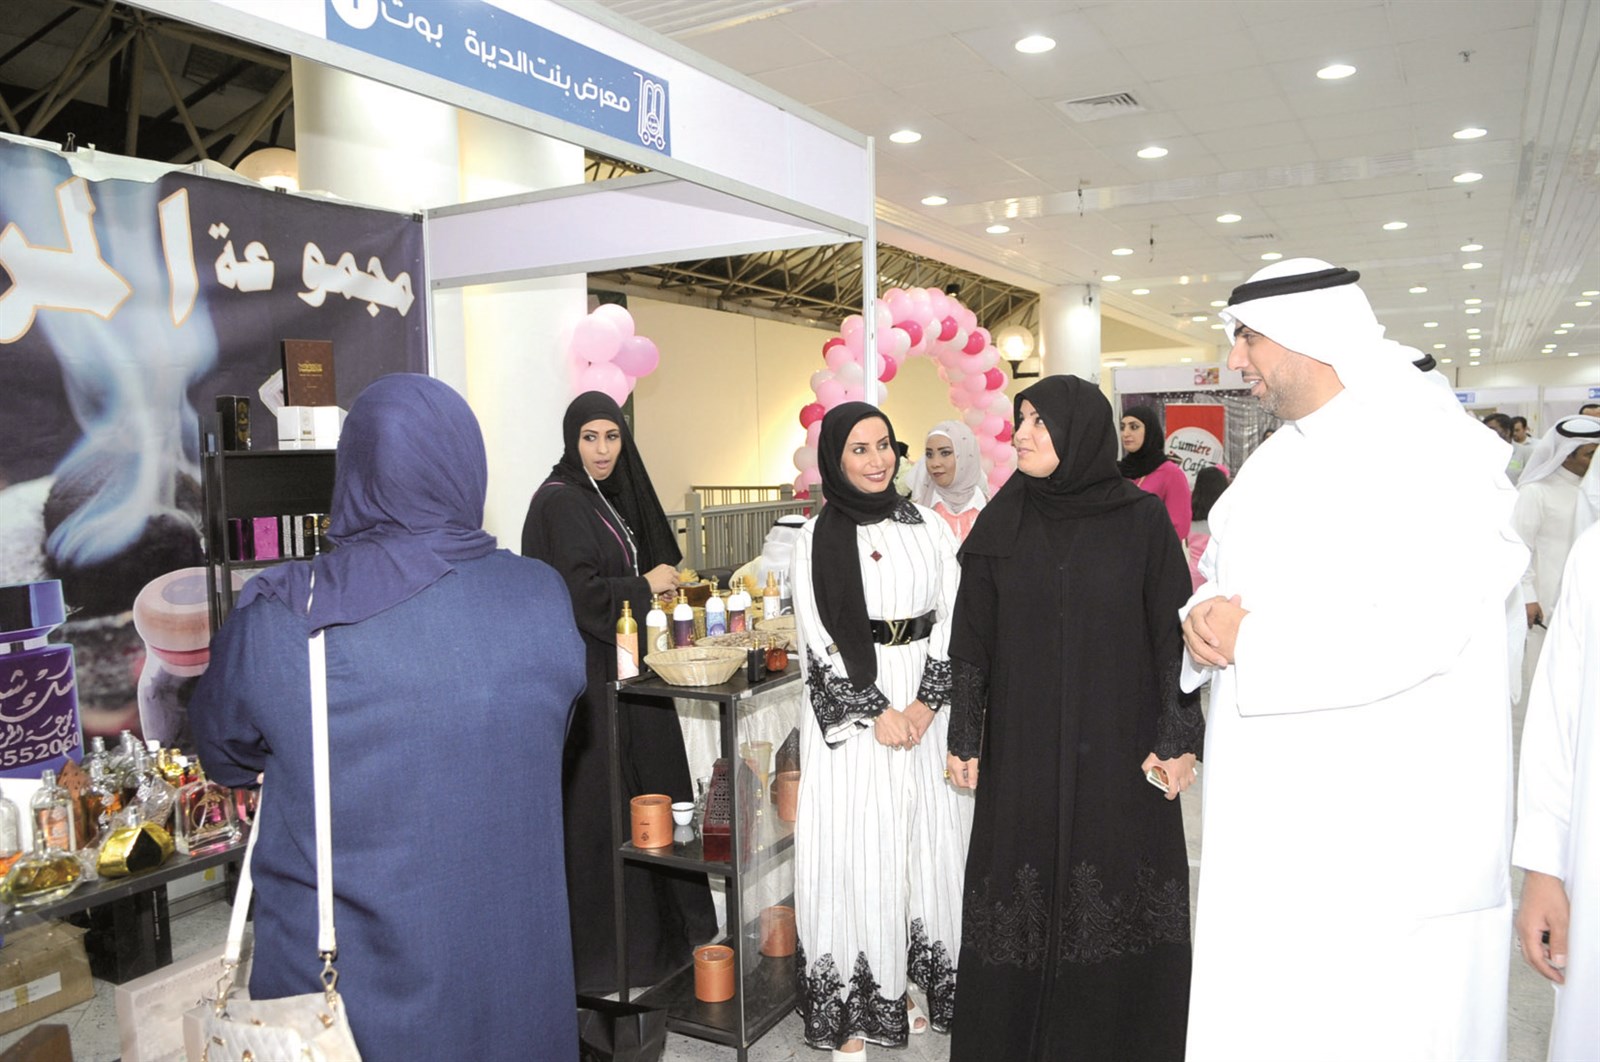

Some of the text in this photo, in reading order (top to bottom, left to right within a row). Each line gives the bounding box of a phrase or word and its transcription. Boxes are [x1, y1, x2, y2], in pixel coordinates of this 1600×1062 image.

[380, 0, 631, 113] معرض بنت الديرة بوت
[208, 221, 415, 318] مجموعة
[0, 731, 80, 766] 552060
